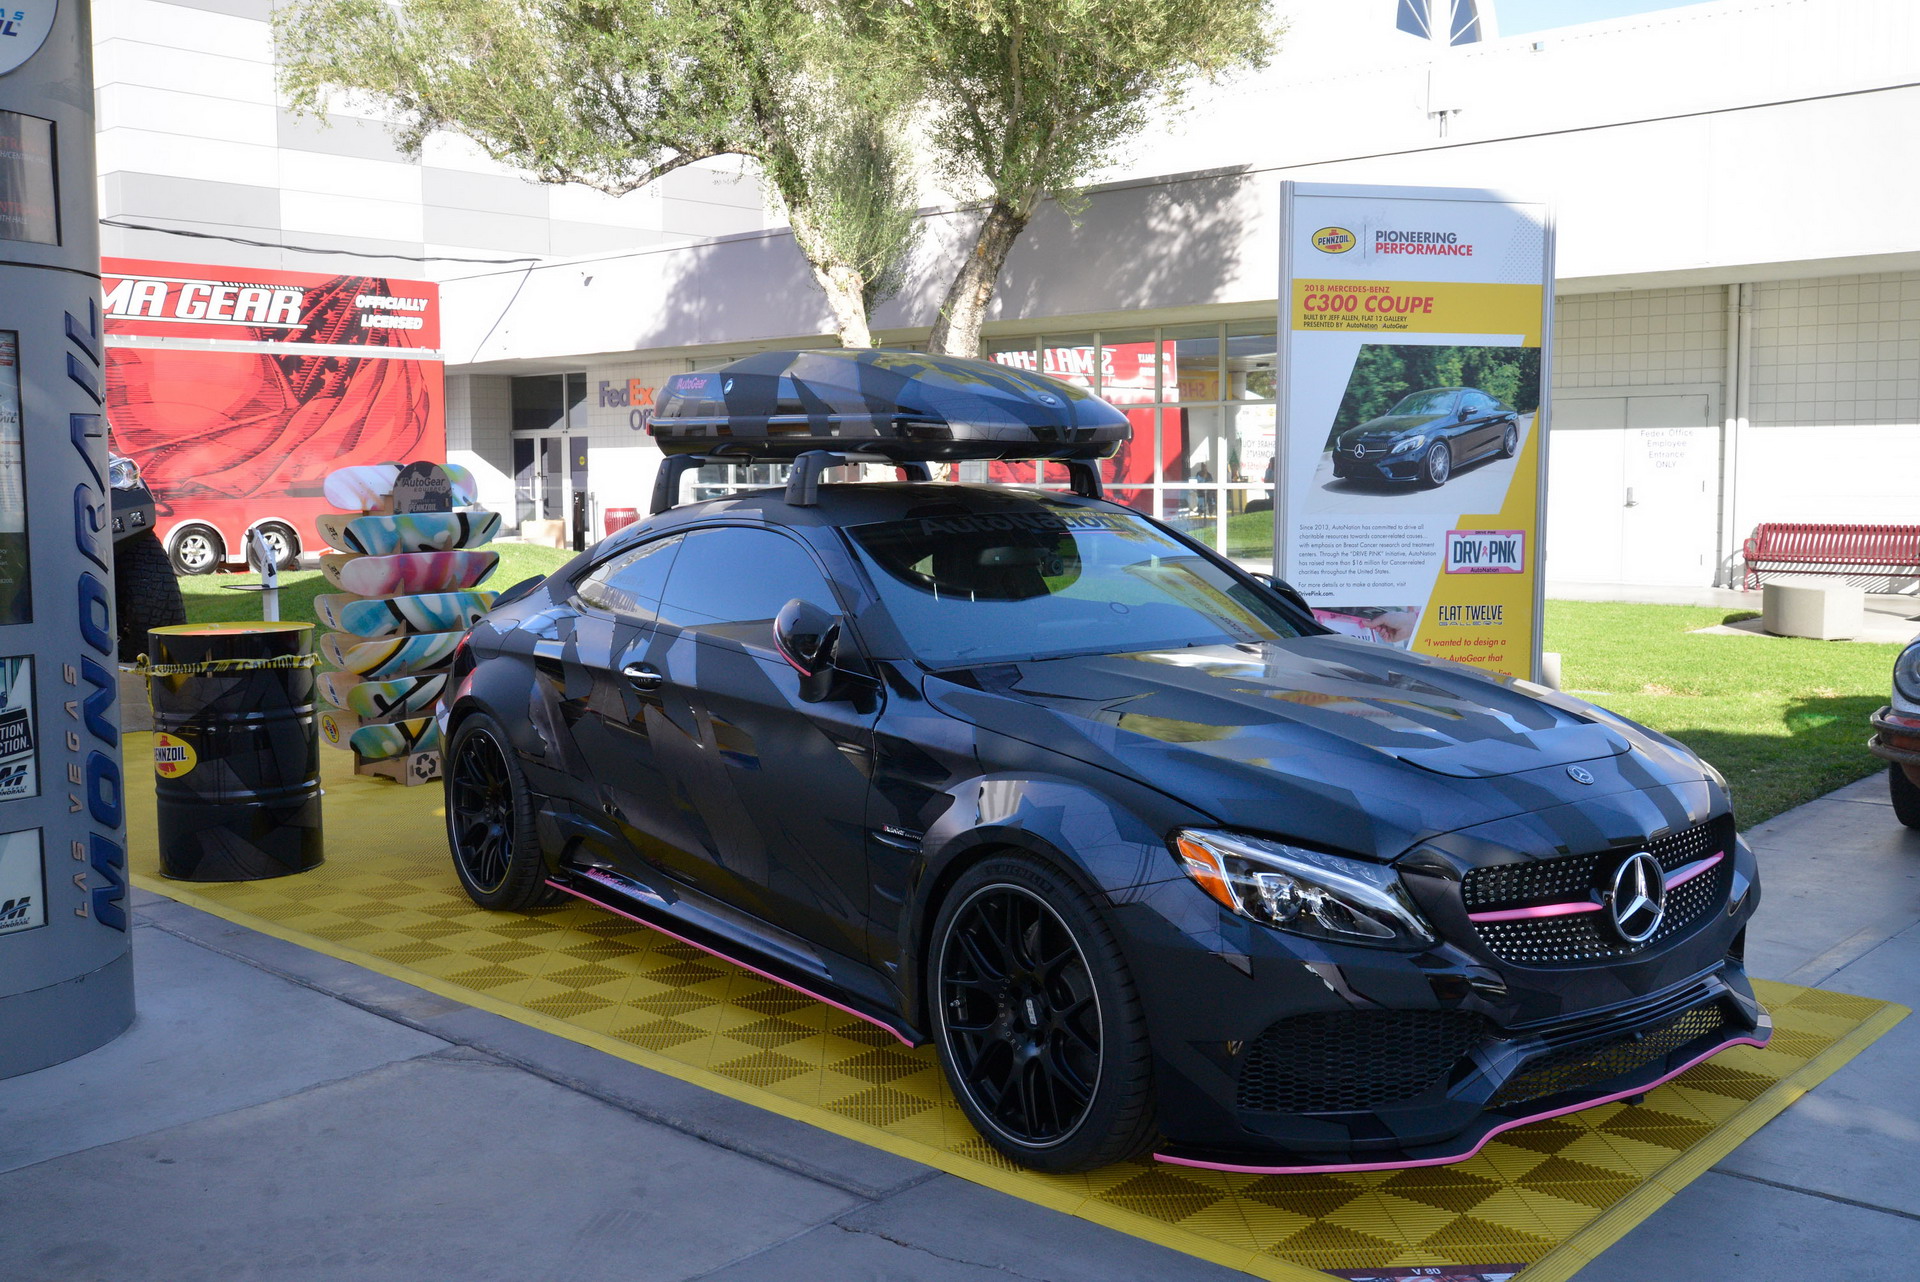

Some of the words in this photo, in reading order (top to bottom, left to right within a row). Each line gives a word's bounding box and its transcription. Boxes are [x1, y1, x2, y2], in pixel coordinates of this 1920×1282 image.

[1317, 234, 1350, 246] PENNZOIL
[1375, 231, 1457, 244] PIONEERING
[1375, 242, 1473, 256] PERFORMANCE
[1304, 284, 1325, 292] 2018
[1327, 285, 1390, 293] MERCEDES-BENZ
[175, 283, 305, 325] GEAR
[355, 294, 428, 312] OFFICIALLY
[1304, 293, 1358, 313] C300
[1364, 295, 1434, 314] COUPE
[361, 313, 423, 330] LICENSED
[676, 378, 707, 389] AutoGear
[599, 378, 654, 408] FedEx
[1648, 440, 1687, 448] Employee
[402, 477, 445, 487] AutoGear
[409, 503, 437, 512] PENNZOIL
[920, 511, 1119, 537] AutoNation
[1453, 540, 1482, 564] DRV
[1489, 540, 1516, 563] PNK
[65, 296, 127, 933] MONORAIL
[1439, 605, 1462, 620] FLAT
[1465, 605, 1503, 620] TWELVE
[1433, 638, 1462, 646] wanted
[1474, 637, 1498, 648] design
[242, 656, 294, 672] CAUTION
[1449, 654, 1485, 662] AutoGear
[1488, 653, 1503, 661] that
[62, 662, 84, 814] VEGAS
[71, 840, 88, 918] LAS
